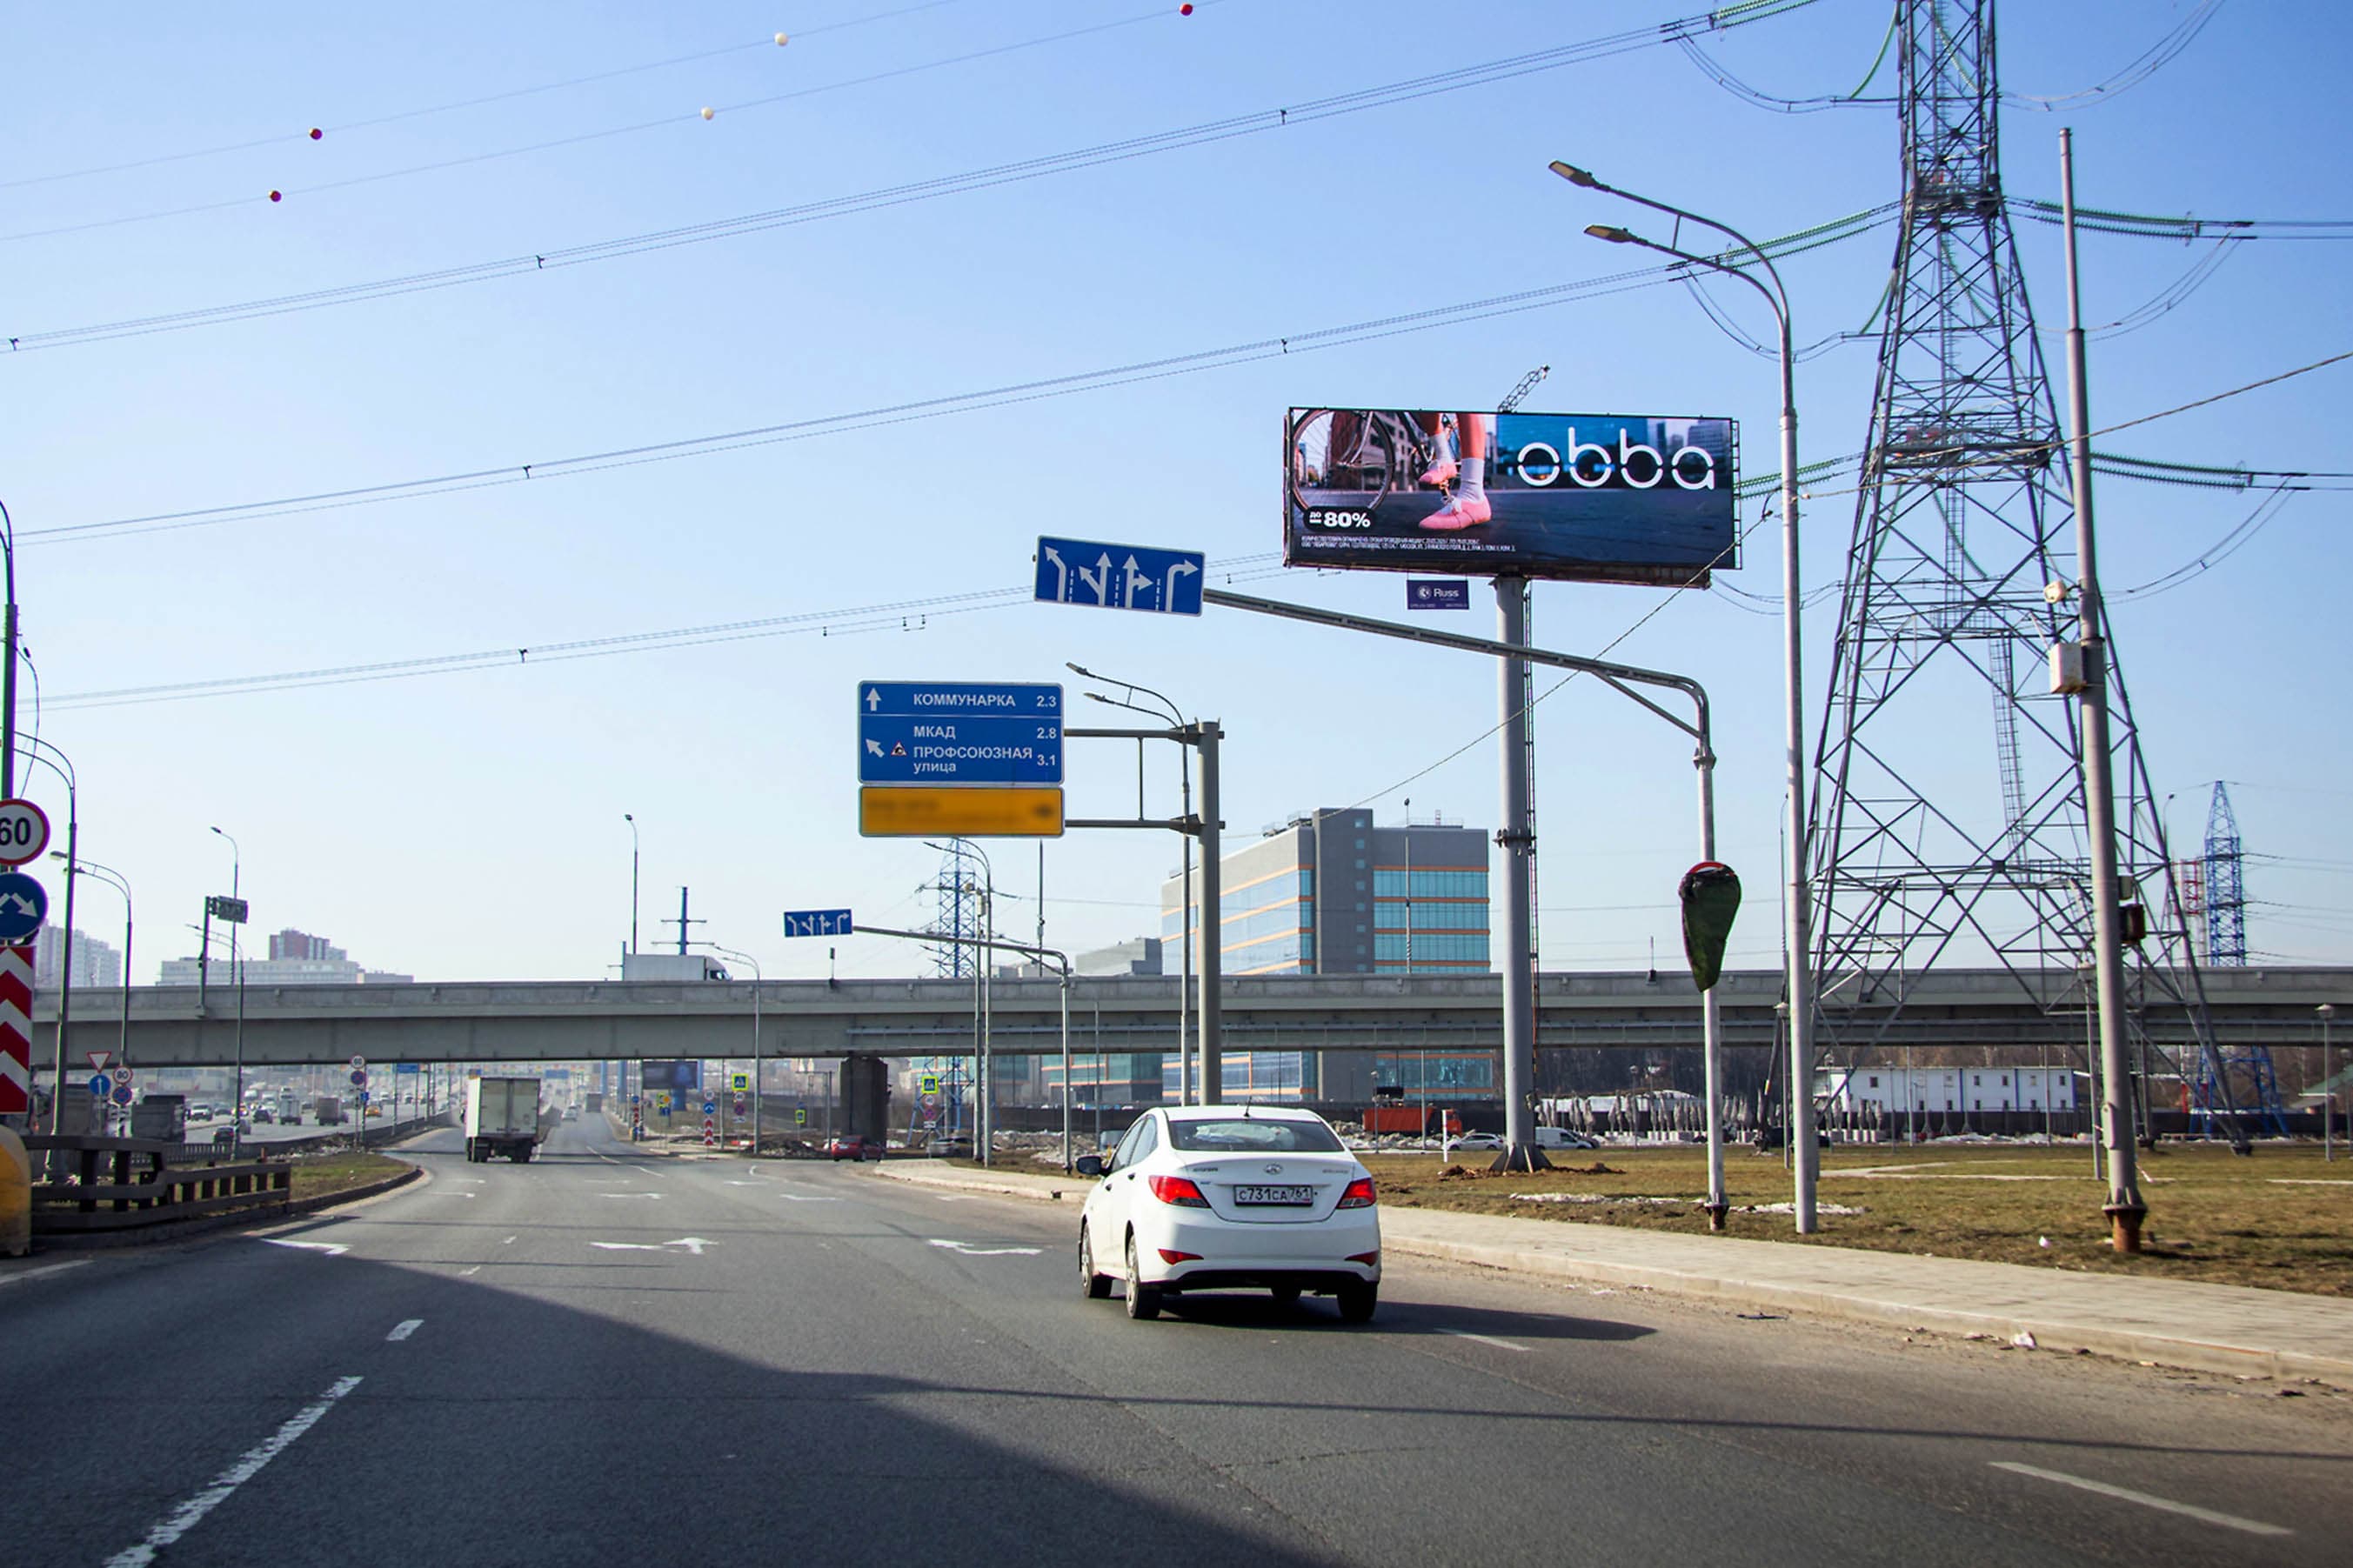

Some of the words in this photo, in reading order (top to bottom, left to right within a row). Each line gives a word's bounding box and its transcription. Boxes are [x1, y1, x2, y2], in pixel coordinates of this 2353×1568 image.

[1517, 426, 1715, 490] obba
[1434, 588, 1460, 597] Russ
[913, 693, 1016, 707] КОММУНАРКА
[1036, 695, 1057, 707] 2.3
[913, 725, 956, 739] МКАД
[1036, 727, 1057, 739] 2.8
[913, 746, 1033, 759] ПРОФСОЮЗНАЯ
[1036, 754, 1056, 766] 3.1
[913, 762, 957, 774] улица
[0, 817, 31, 846] 60
